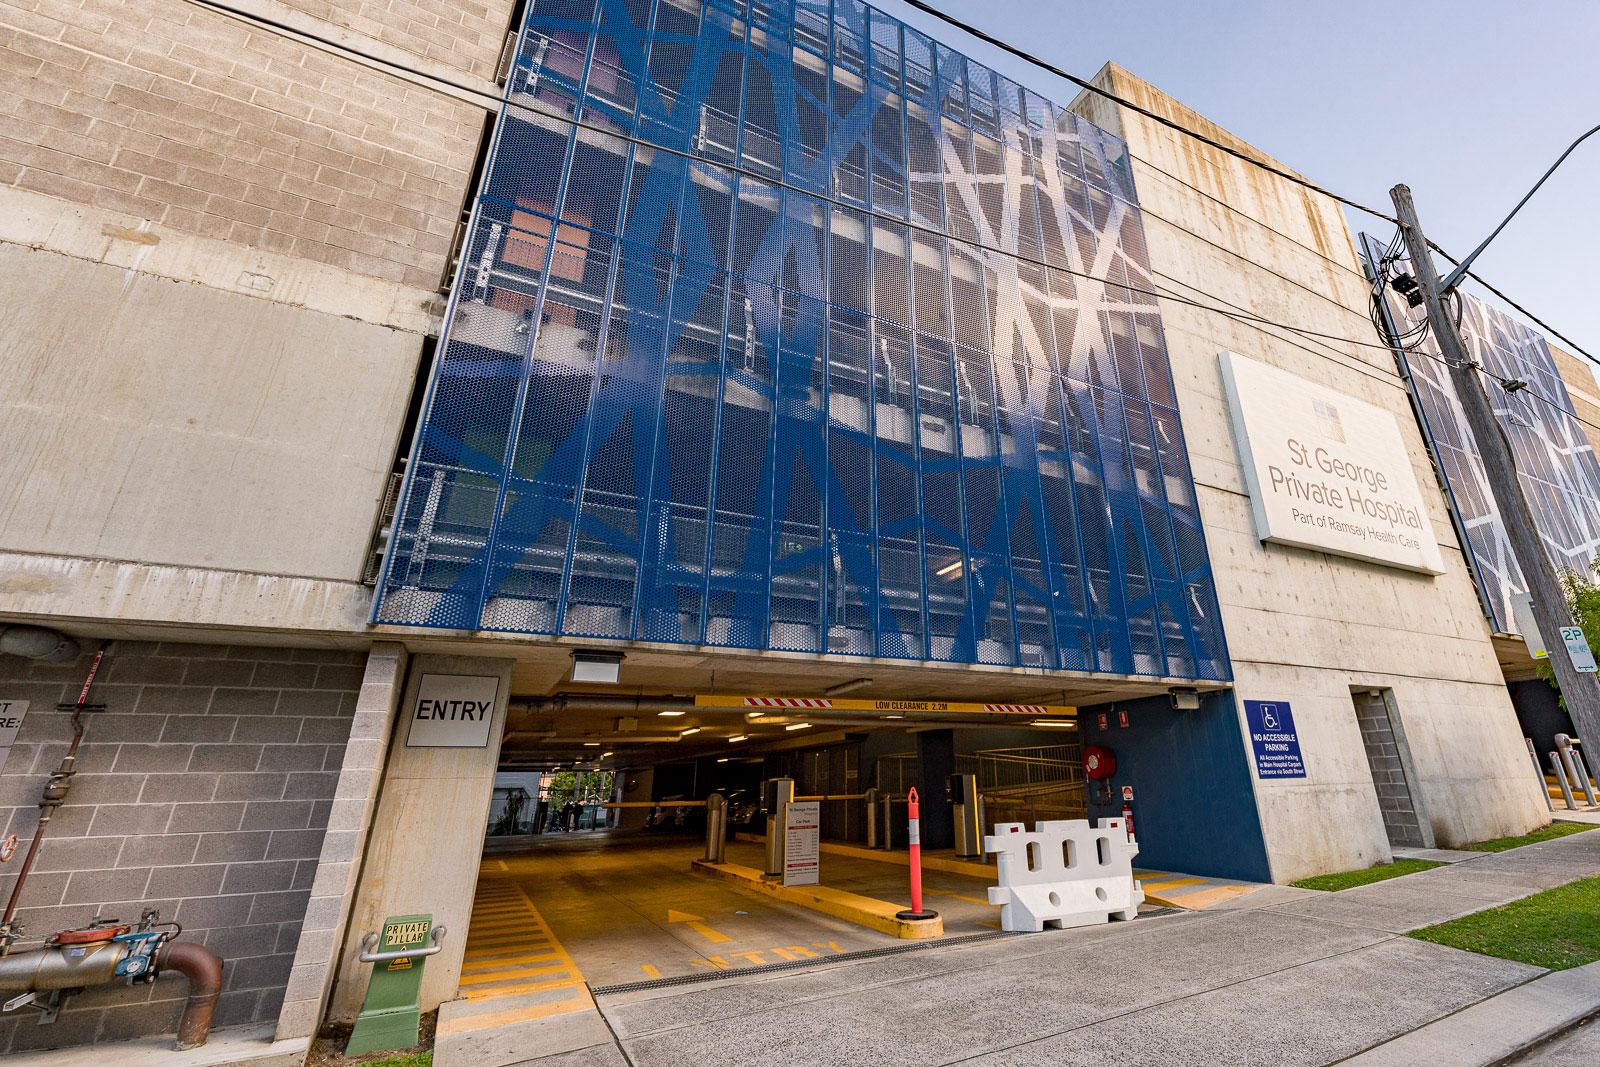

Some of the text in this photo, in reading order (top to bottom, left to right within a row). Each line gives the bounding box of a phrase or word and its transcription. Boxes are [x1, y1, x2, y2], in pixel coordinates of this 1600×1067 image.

[1287, 438, 1388, 494] St George
[1268, 465, 1424, 531] Private Hospital
[1292, 508, 1420, 550] Part of Ramsay Health Care
[1562, 630, 1581, 640] 2P
[416, 699, 491, 721] ENTRY
[876, 701, 890, 710] LOW
[892, 702, 929, 710] CLEARANCE
[387, 922, 428, 934] PRIVATE
[388, 932, 423, 944] PILLAR
